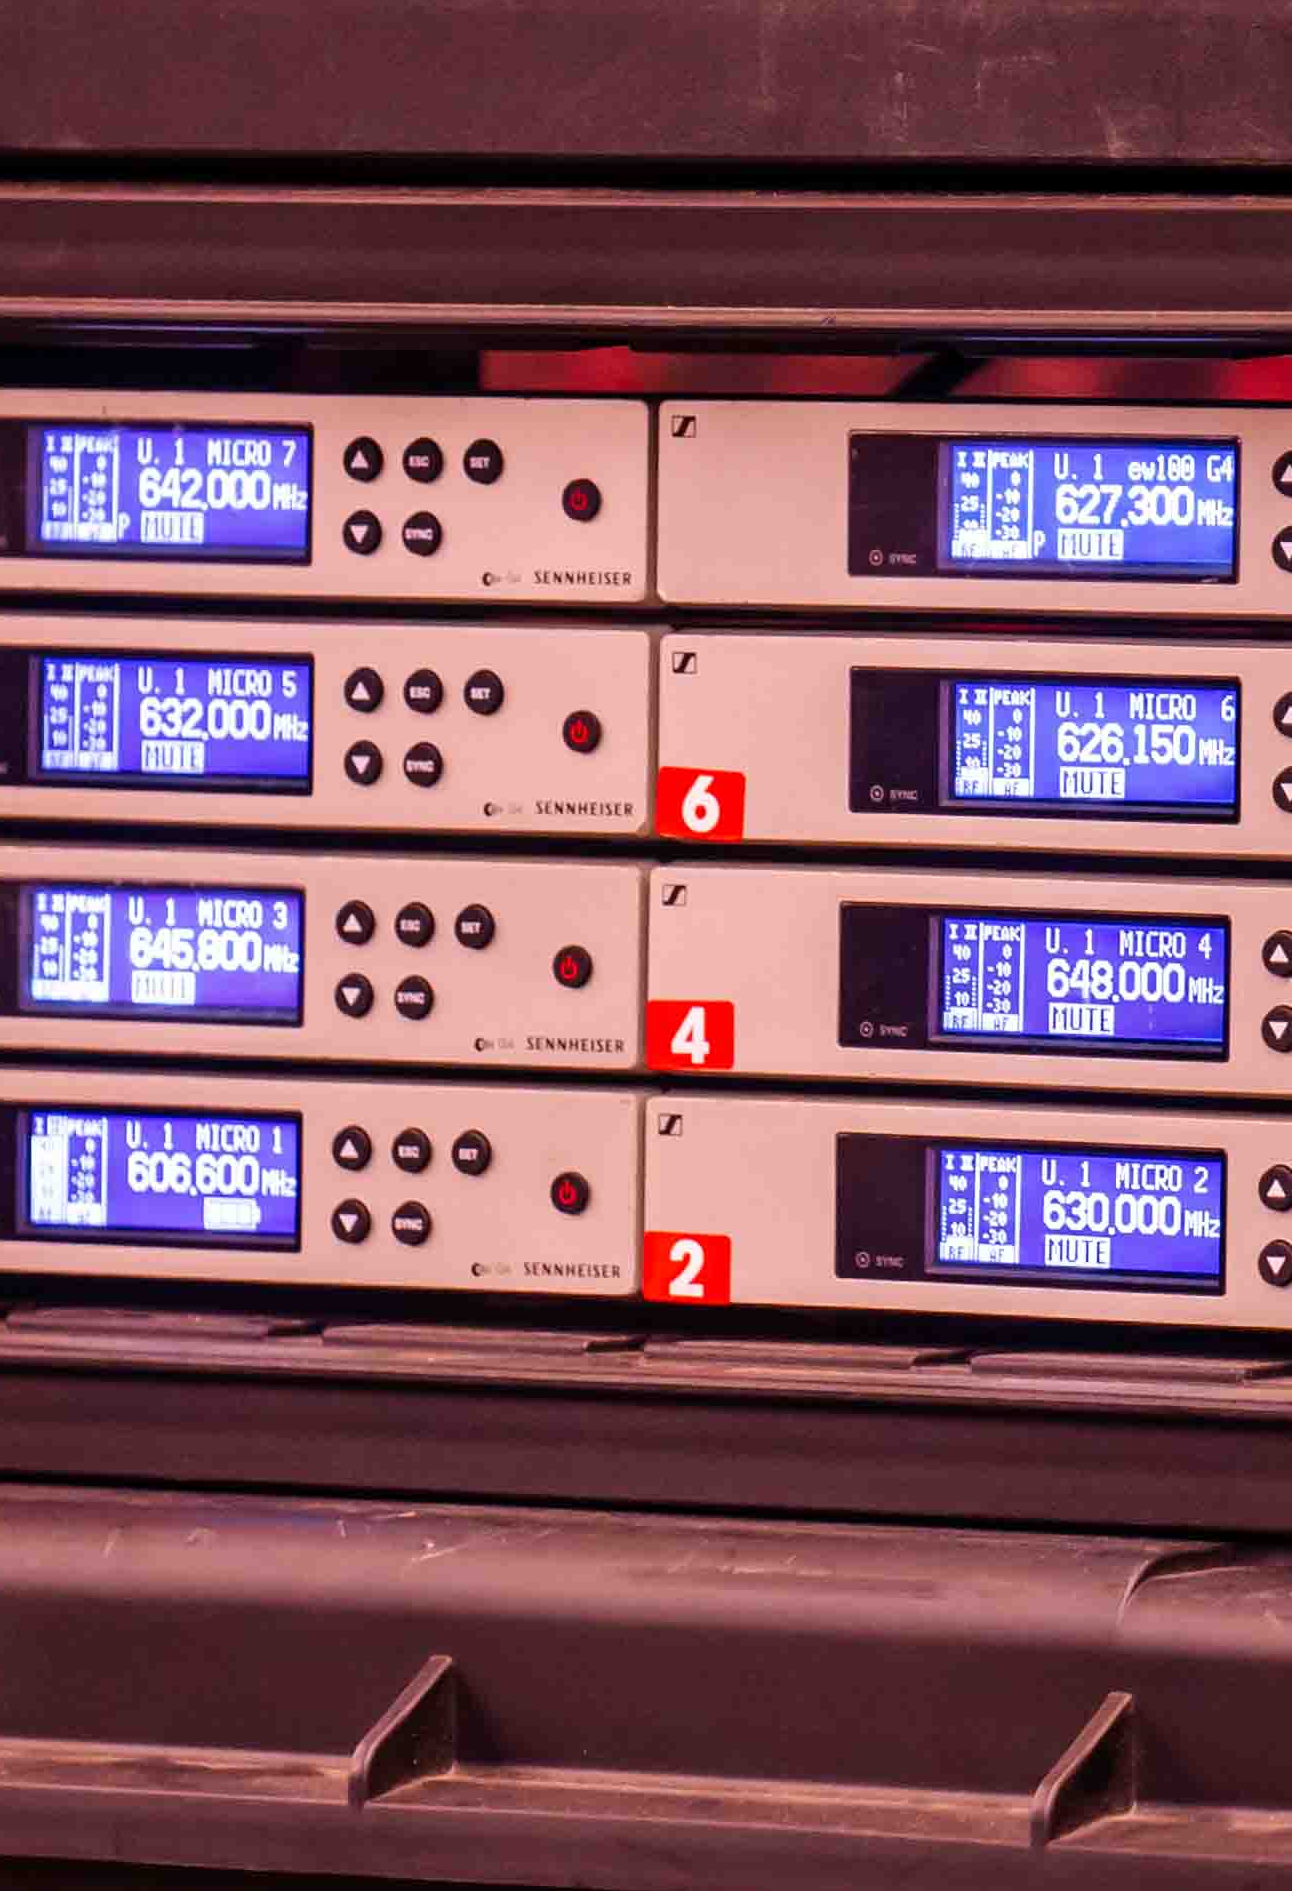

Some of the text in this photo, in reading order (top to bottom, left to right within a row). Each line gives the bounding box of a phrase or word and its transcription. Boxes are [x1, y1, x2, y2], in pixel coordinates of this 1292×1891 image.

[137, 438, 296, 465] U. 1 MICRO 7
[1054, 453, 1233, 481] U. 1 ew100 G4
[139, 469, 307, 511] 642.000 MHz
[1056, 485, 1233, 527] 627.300 MHz
[1061, 531, 1121, 557] MUTE
[534, 571, 631, 585] SENNHEISER
[138, 667, 297, 696] U. 1 MICRO 5
[140, 698, 308, 741] 632.000 MHz
[1056, 691, 1235, 721] U. 1 MICRO 6
[1058, 724, 1235, 766] 626.150 MHz
[1063, 769, 1122, 796] MUTE
[536, 801, 633, 816] SENNHEISER
[682, 775, 719, 832] 6
[128, 897, 288, 929] U. 1 MICRO 3
[130, 928, 298, 972] 645.800 MHz
[1046, 927, 1211, 958] U. 1 MICRO 4
[1048, 959, 1224, 1003] 648.000 MHz
[1053, 1006, 1112, 1032] MUTE
[527, 1037, 624, 1053] SENNHEISER
[671, 1007, 709, 1064] 4
[126, 1121, 282, 1153] U. 1 MICRO 1
[128, 1152, 297, 1197] 606.600 MHz
[1042, 1159, 1208, 1192] U. 1 MICRO 2
[1043, 1190, 1220, 1237] 630.000 MHz
[1049, 1238, 1108, 1264] MUTE
[524, 1262, 620, 1278] SENNHEISER
[669, 1239, 704, 1297] 2
